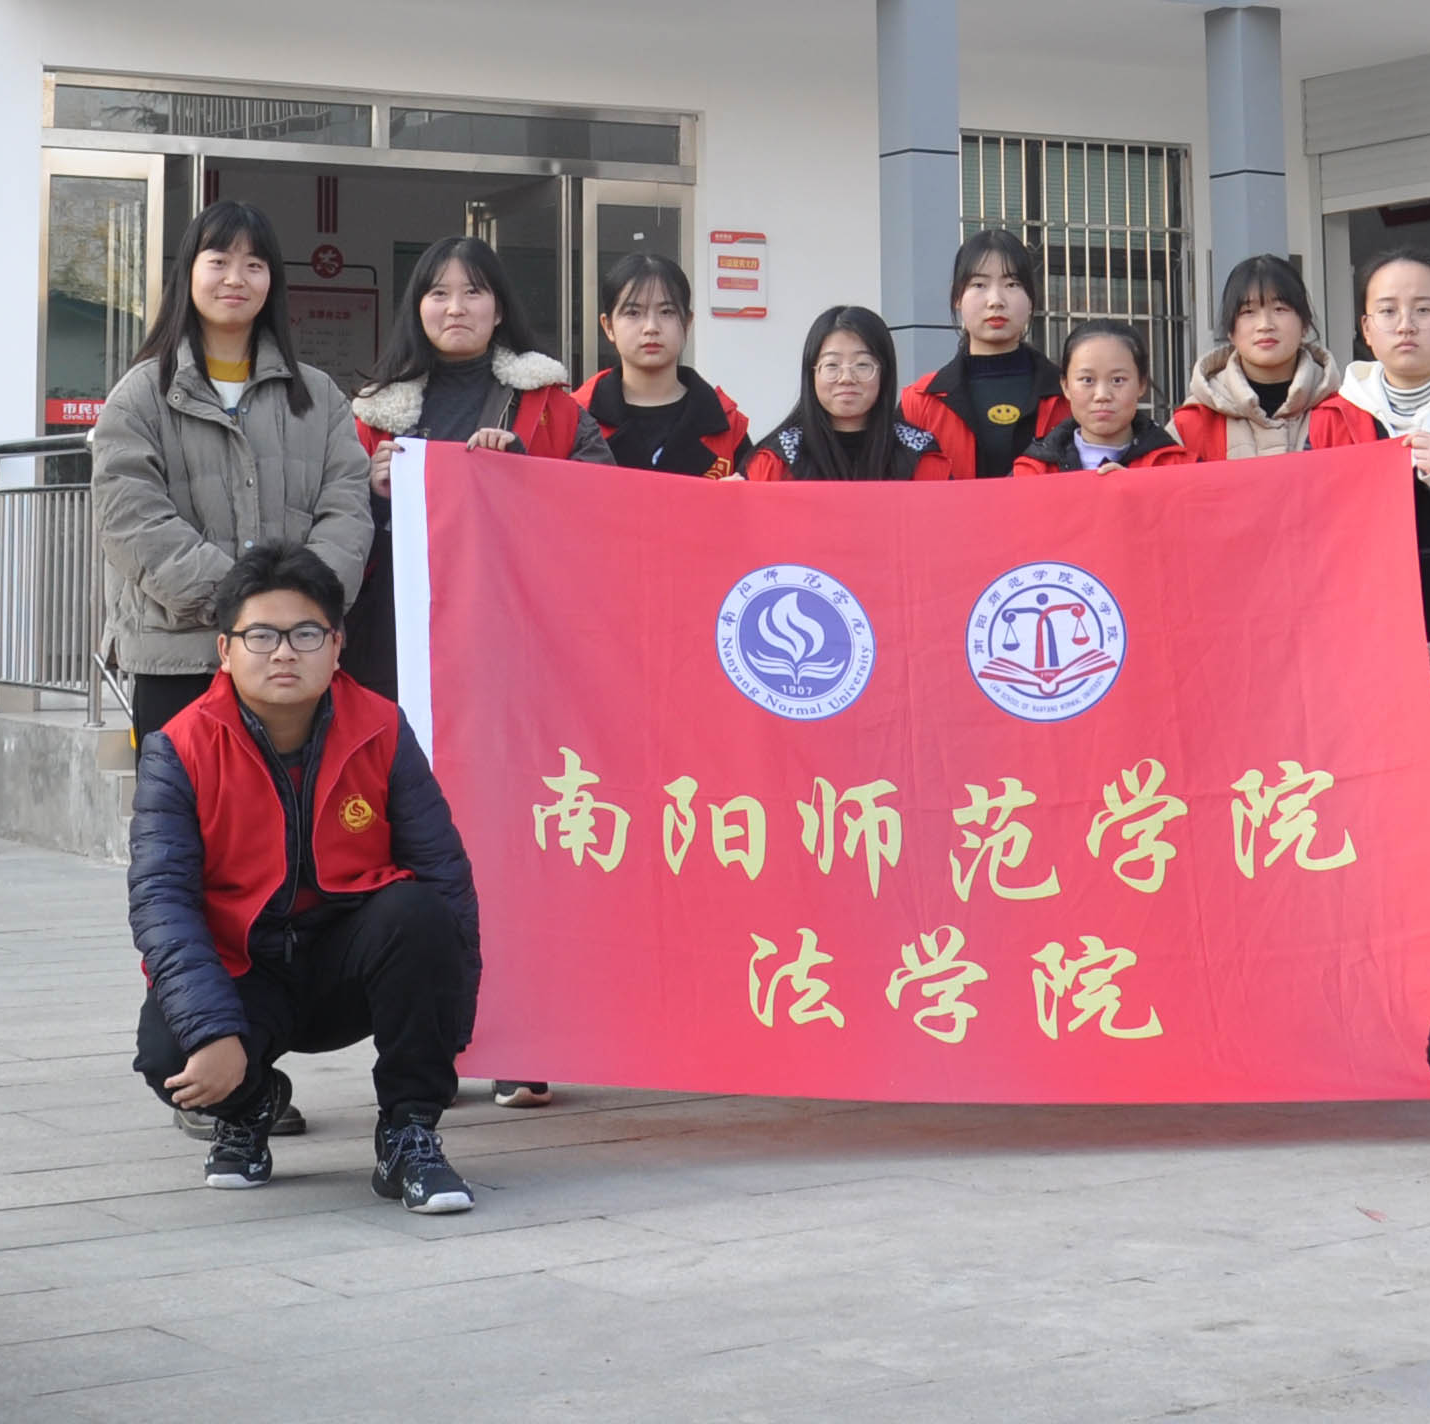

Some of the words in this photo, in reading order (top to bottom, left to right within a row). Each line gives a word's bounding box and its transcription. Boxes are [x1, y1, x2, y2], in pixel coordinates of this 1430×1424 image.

[973, 569, 1118, 655] 南阳师范学院法学院
[722, 636, 761, 698] Nanyang
[764, 695, 823, 716] Normal
[828, 645, 873, 710] University
[781, 684, 813, 696] 1907
[532, 746, 1356, 901] 南阳师范学院
[748, 925, 1164, 1044] 法学院
